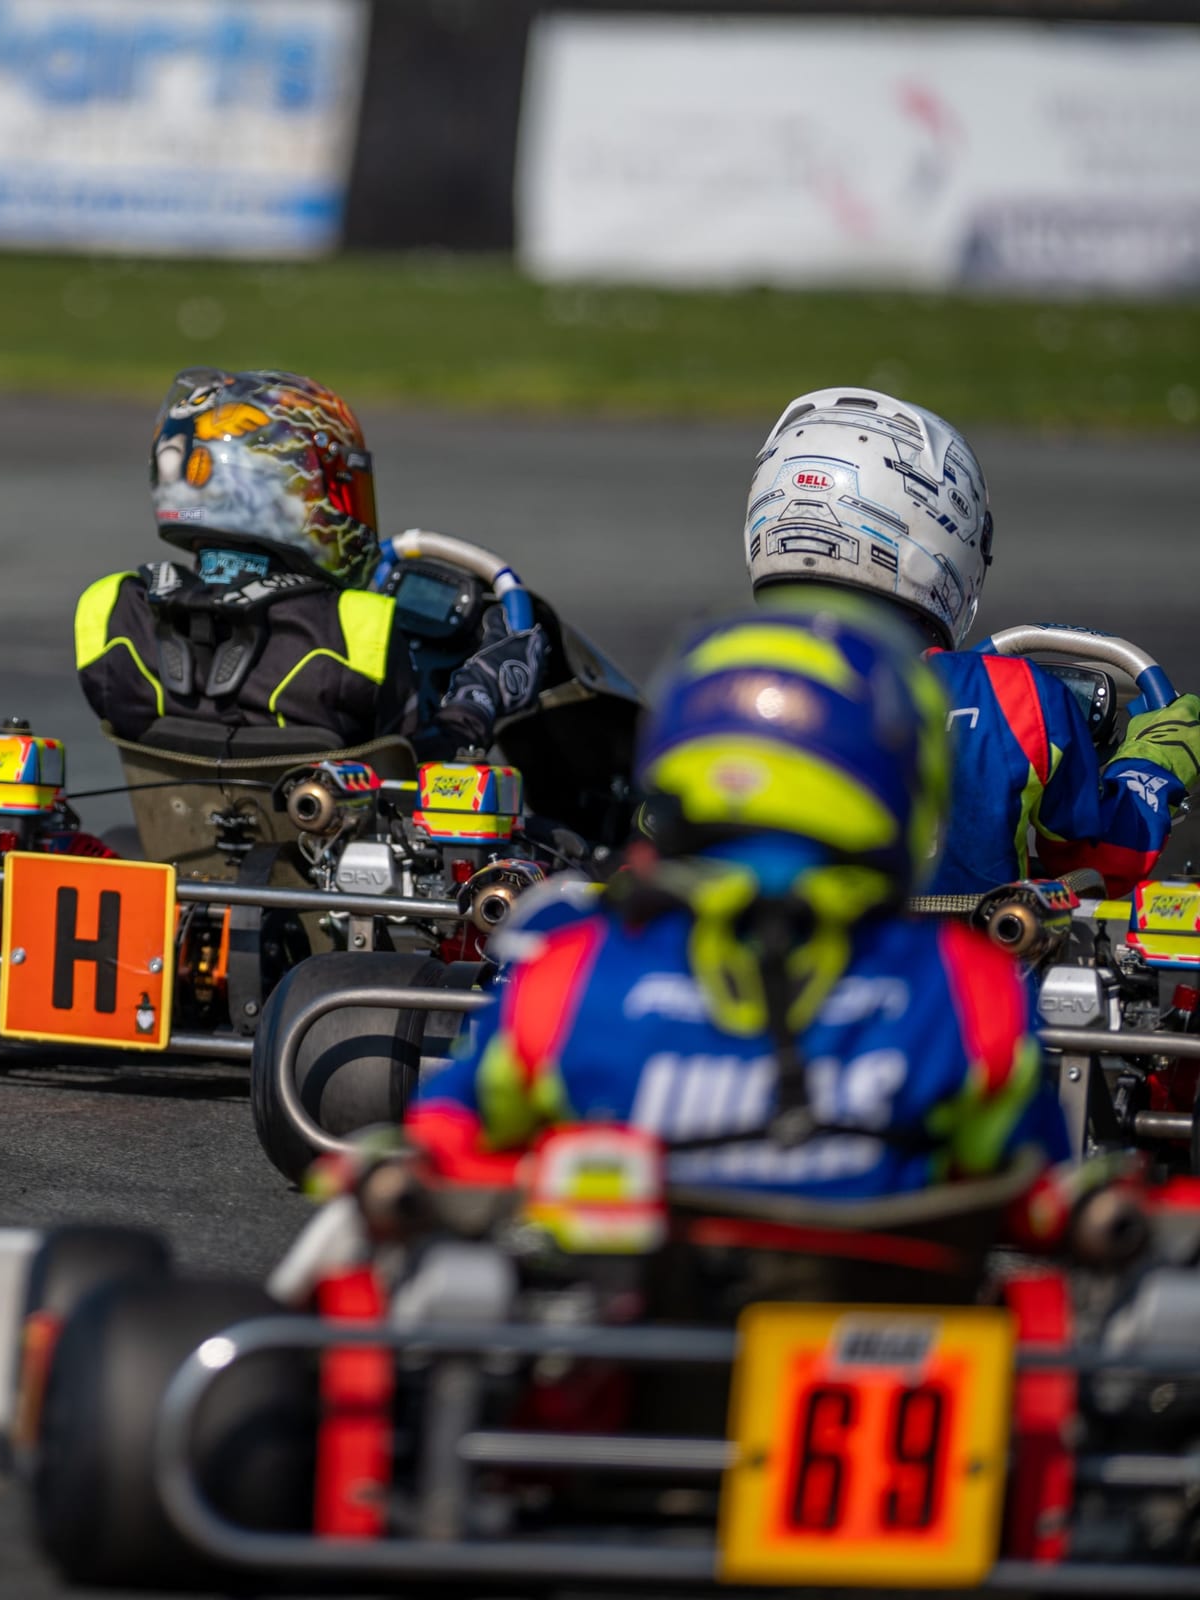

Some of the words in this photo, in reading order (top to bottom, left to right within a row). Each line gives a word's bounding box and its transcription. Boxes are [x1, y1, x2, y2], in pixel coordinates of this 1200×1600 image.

[797, 474, 828, 487] BELL
[951, 491, 969, 516] BELL
[339, 868, 389, 886] OHV
[52, 886, 121, 1013] H
[1039, 996, 1097, 1014] OHV
[787, 1383, 950, 1534] 69
